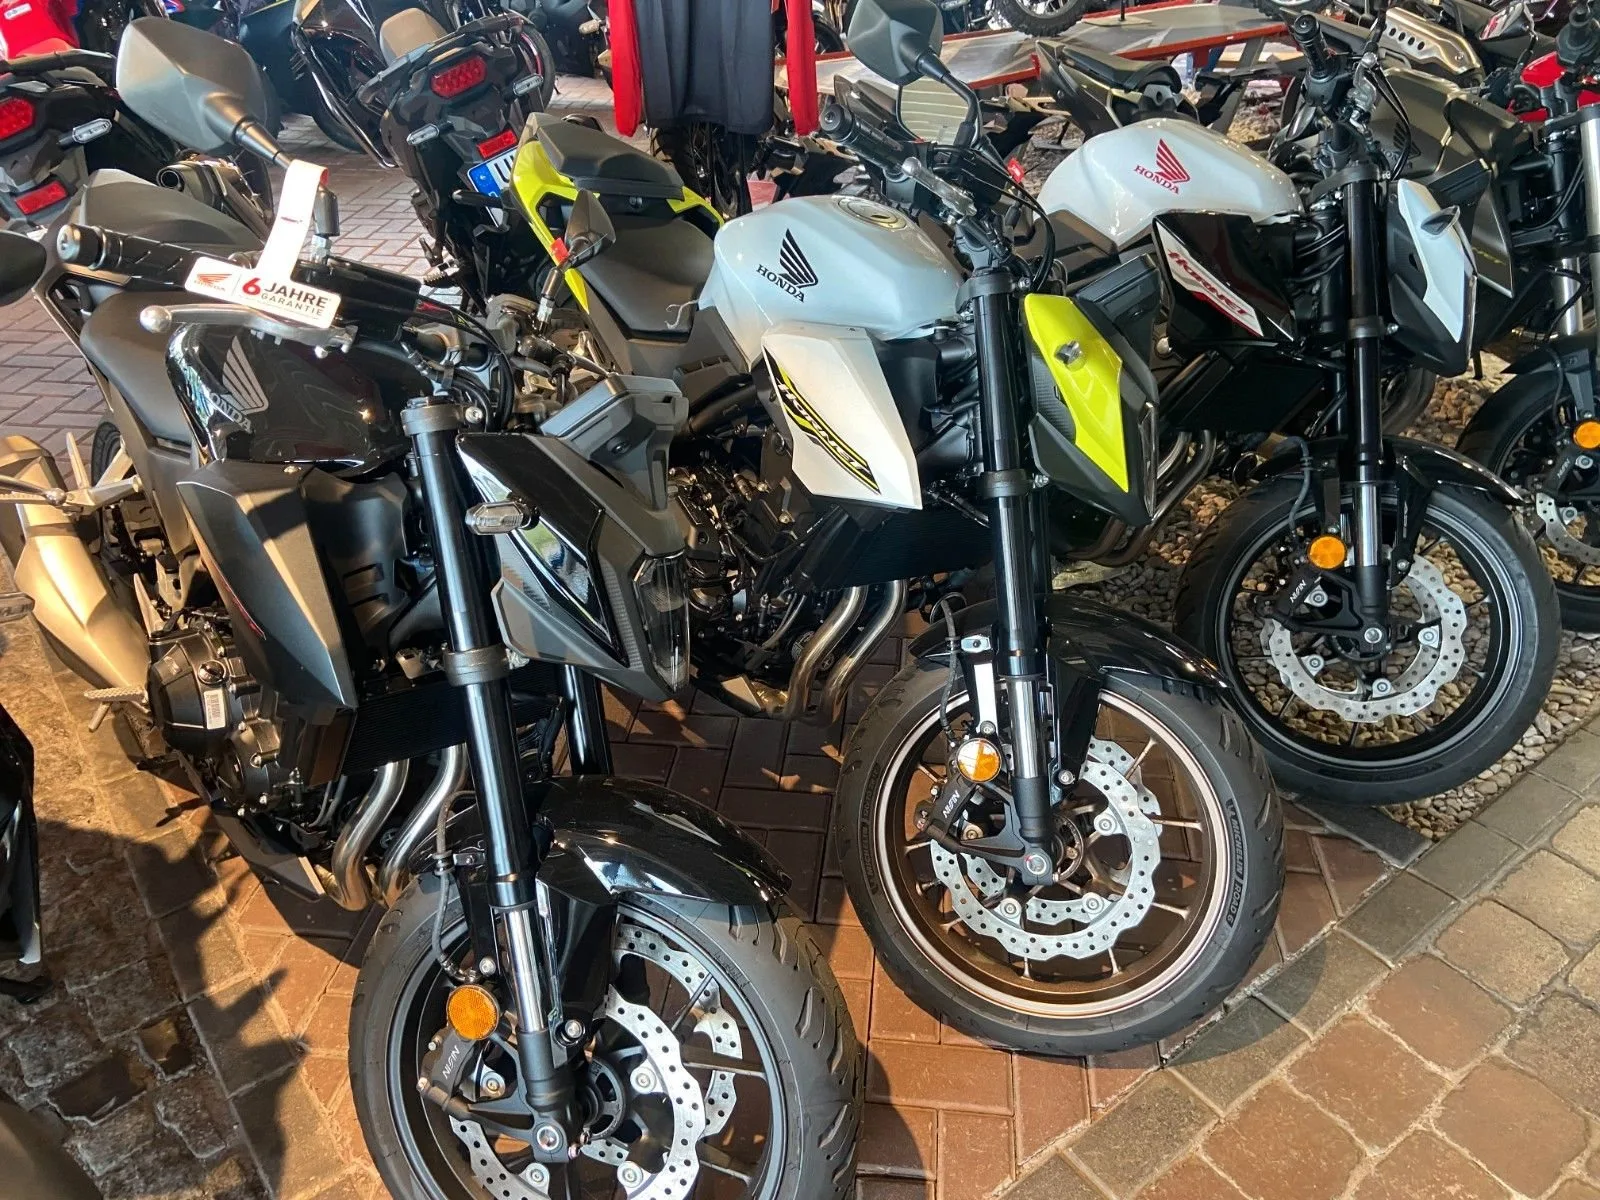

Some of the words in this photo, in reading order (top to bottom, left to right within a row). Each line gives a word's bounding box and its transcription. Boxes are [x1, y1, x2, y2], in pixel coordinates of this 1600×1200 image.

[1134, 165, 1179, 194] HONDA
[242, 277, 261, 295] 6
[756, 264, 805, 303] HONDA
[1168, 249, 1250, 316] HORNET
[261, 294, 324, 317] GARANTIE
[777, 378, 870, 474] HORNET
[1231, 821, 1244, 874] MICHELIN
[1230, 884, 1242, 914] ROAD
